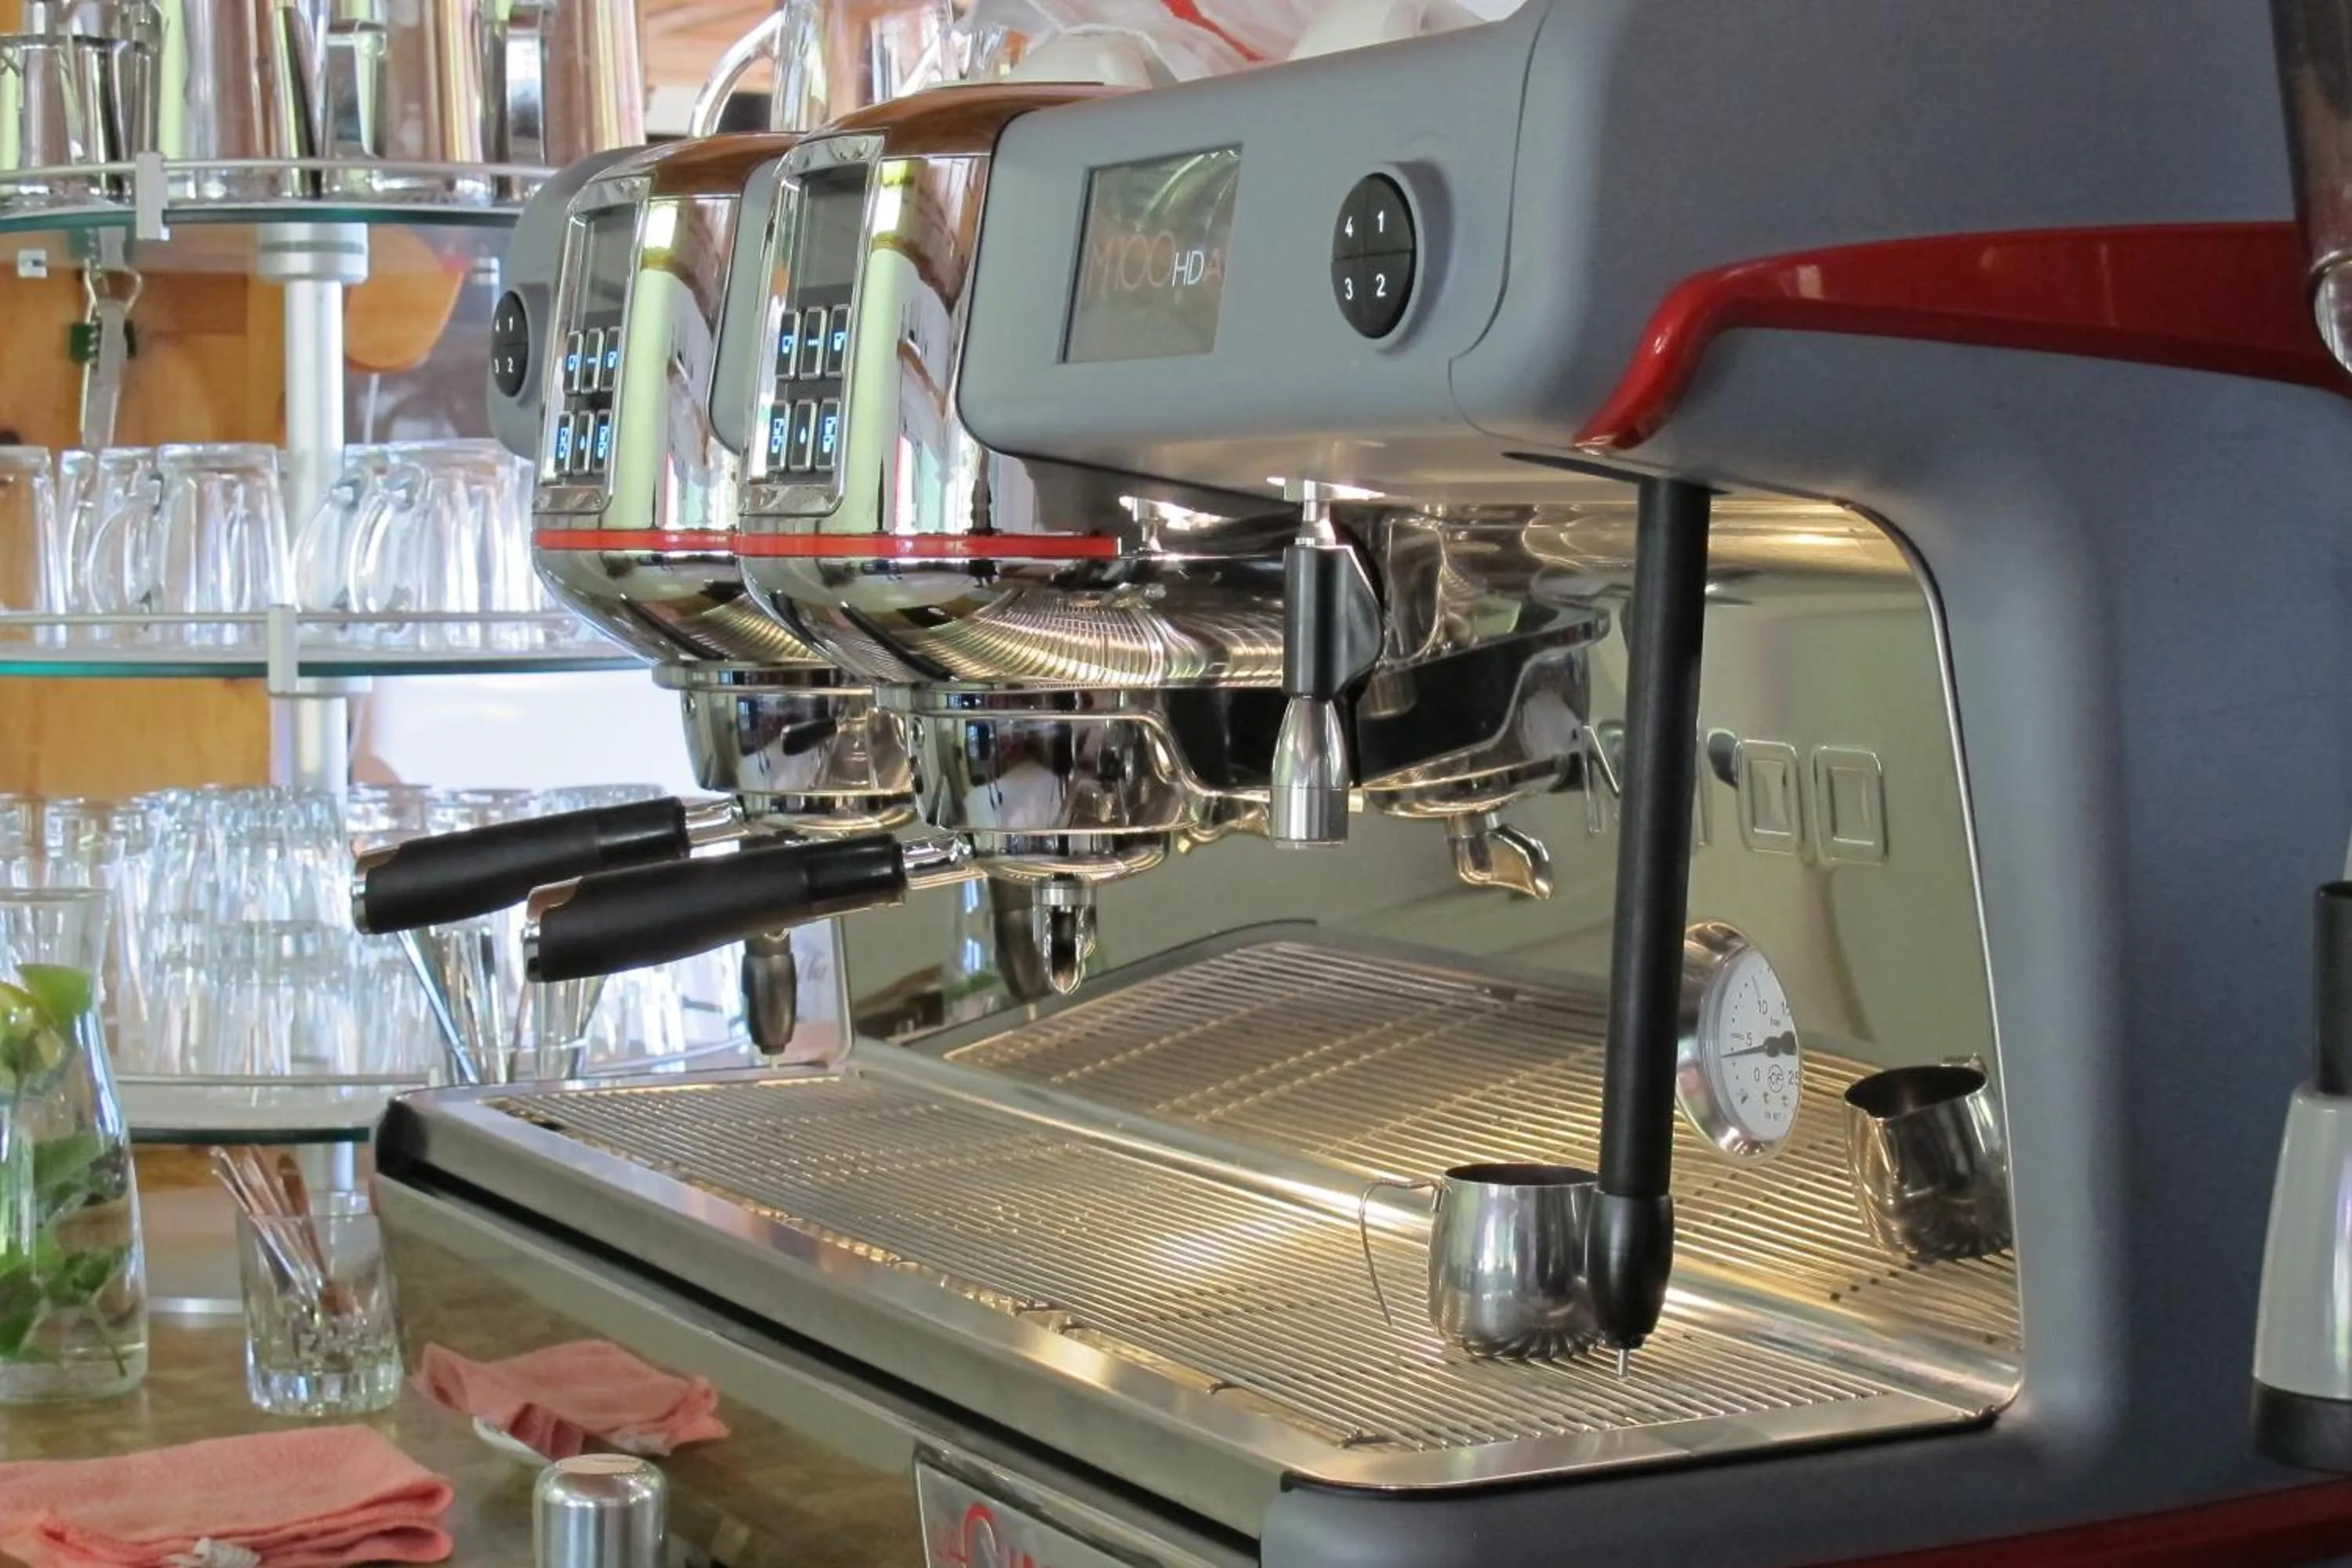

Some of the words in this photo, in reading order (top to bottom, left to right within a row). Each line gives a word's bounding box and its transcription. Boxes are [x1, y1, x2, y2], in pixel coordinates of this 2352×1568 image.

[1345, 216, 1353, 238] 4
[1377, 210, 1385, 233] 1
[1345, 277, 1353, 300] 3
[1376, 273, 1386, 297] 2
[507, 316, 514, 332] 1
[494, 358, 499, 373] 3
[507, 357, 514, 373] 2
[1758, 1000, 1768, 1014] 10
[1755, 1067, 1759, 1081] 0
